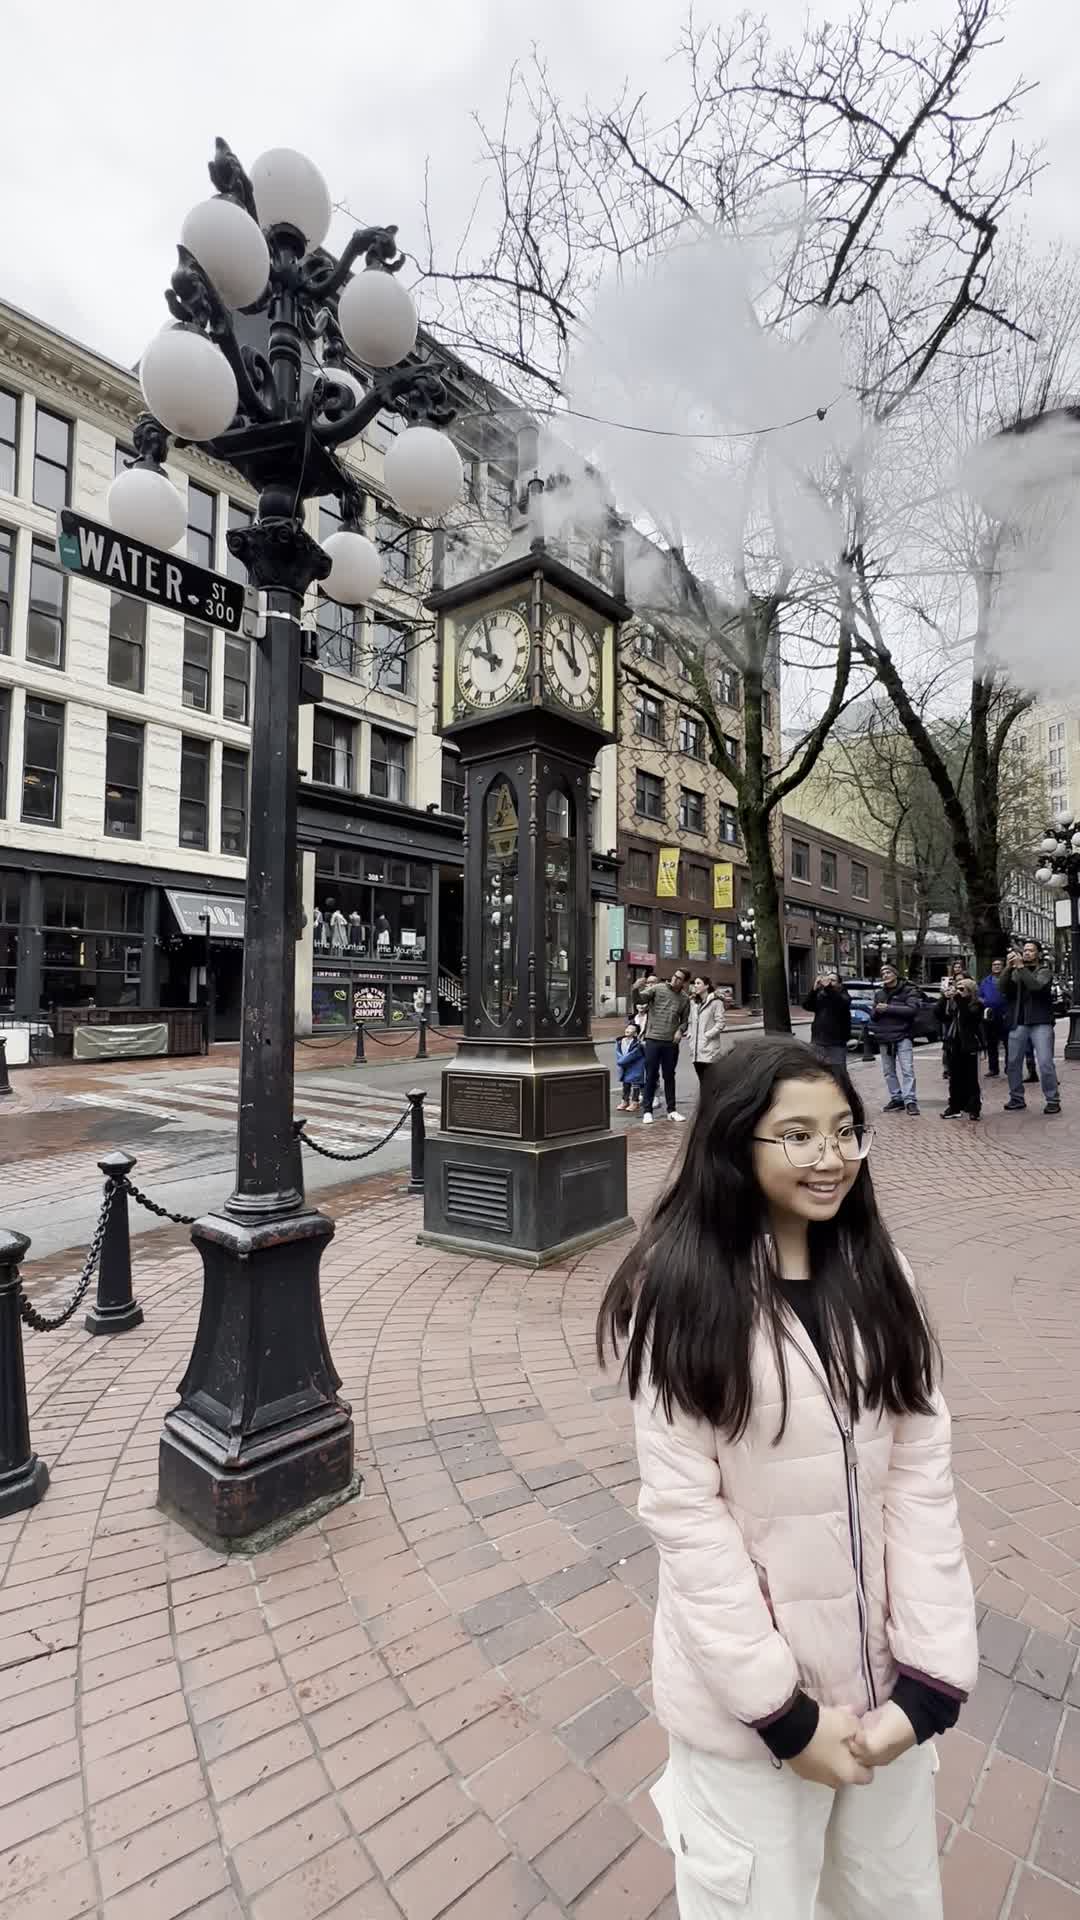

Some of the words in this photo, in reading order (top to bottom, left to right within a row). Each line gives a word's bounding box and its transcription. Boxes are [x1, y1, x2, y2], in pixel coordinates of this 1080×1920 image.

[78, 526, 183, 604] WATER
[211, 582, 227, 602] ST
[205, 598, 235, 623] 300
[355, 1001, 384, 1009] CANDY
